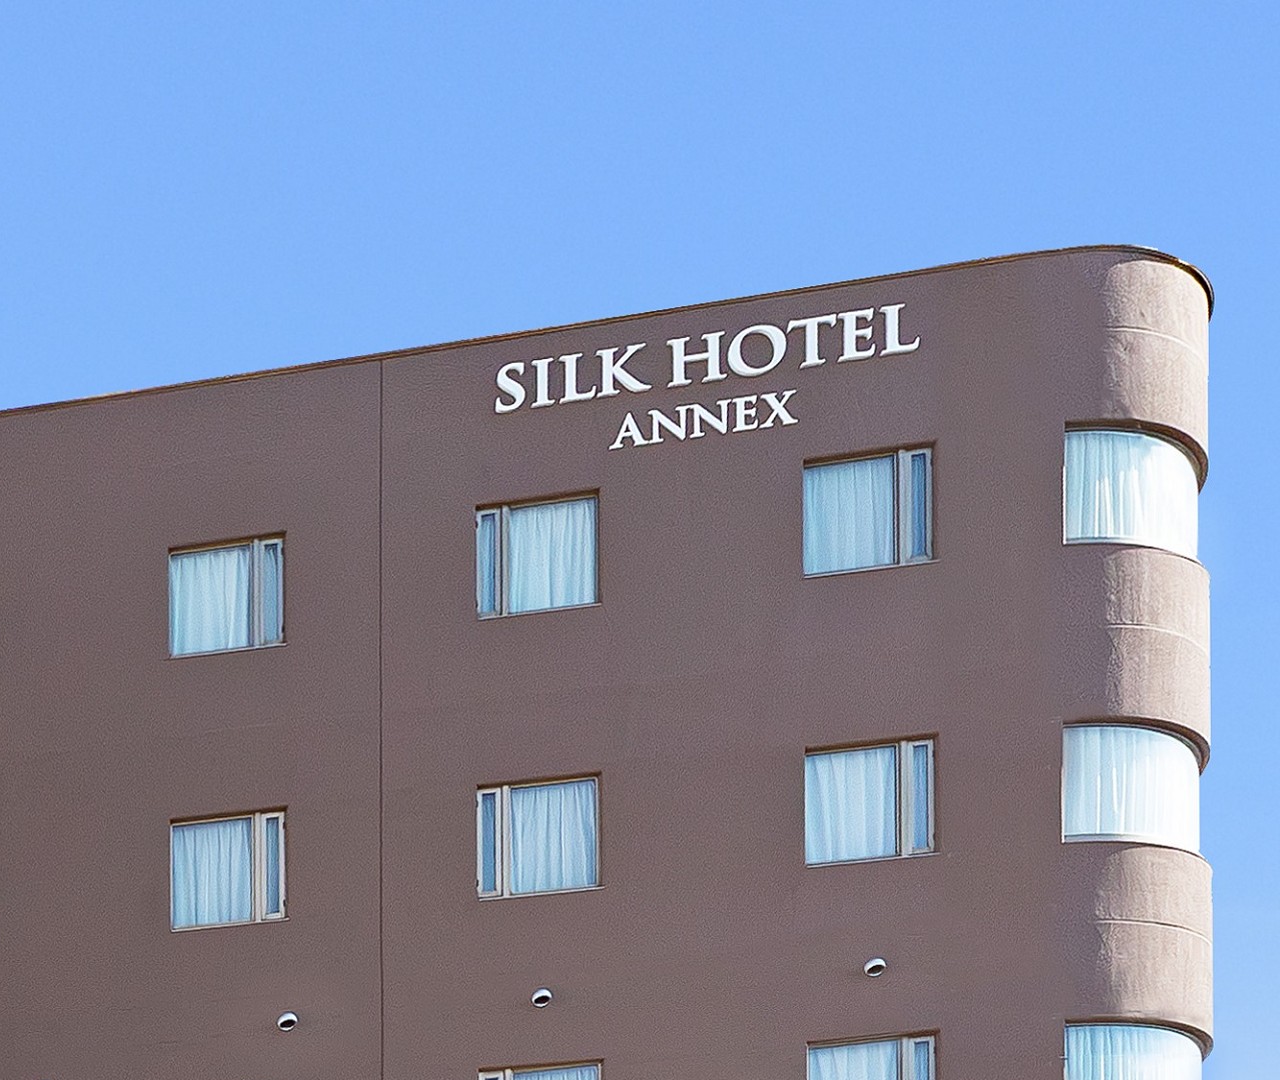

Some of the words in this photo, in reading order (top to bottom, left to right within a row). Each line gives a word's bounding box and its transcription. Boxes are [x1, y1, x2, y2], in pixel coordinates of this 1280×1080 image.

[494, 341, 653, 415] SILK
[666, 302, 922, 389] HOTEL
[607, 388, 800, 451] ANNEX
